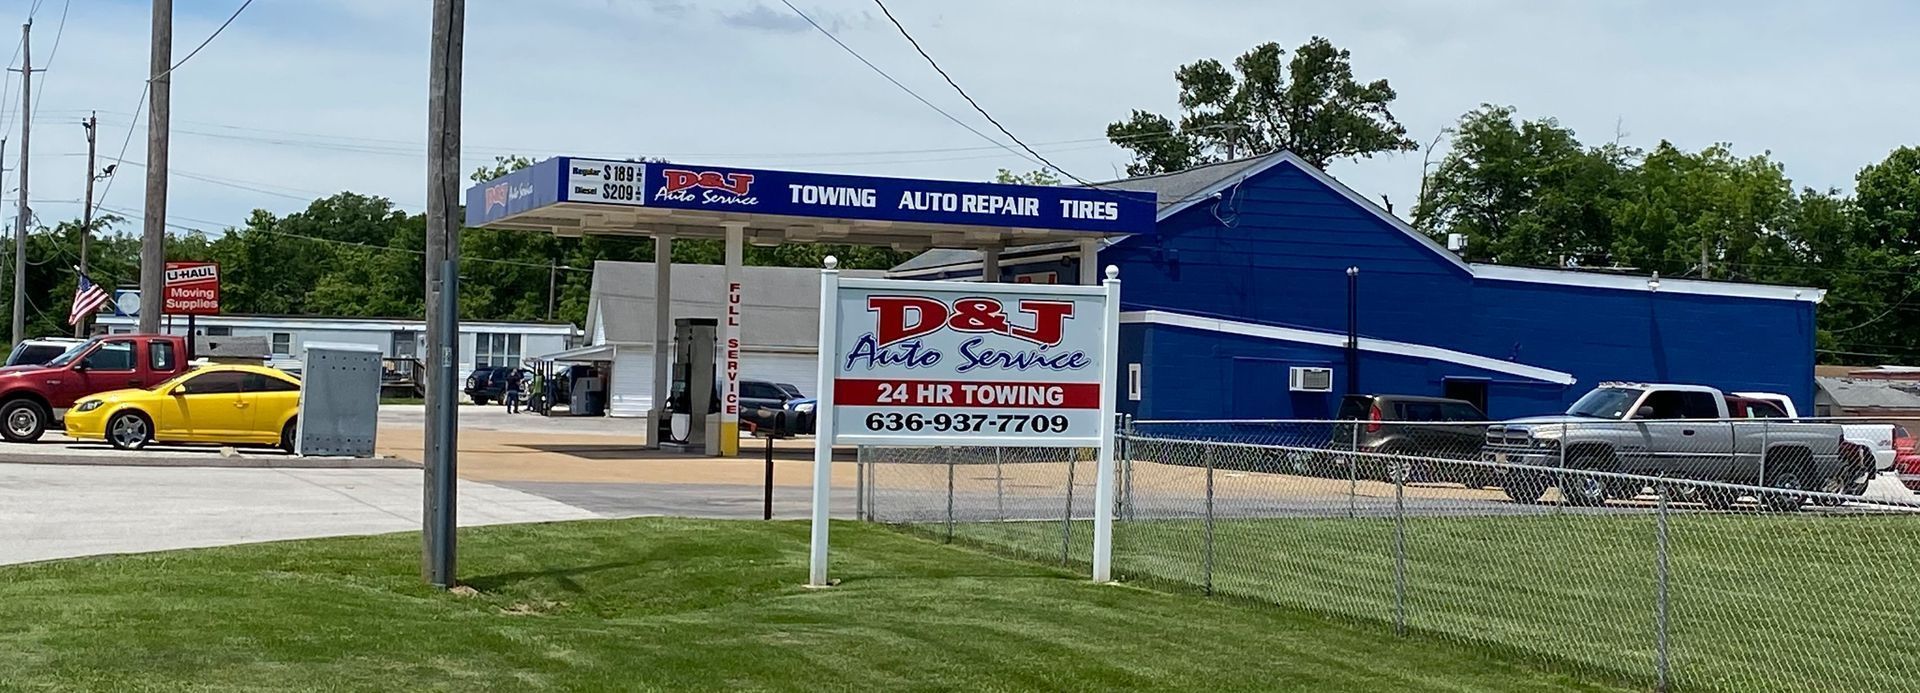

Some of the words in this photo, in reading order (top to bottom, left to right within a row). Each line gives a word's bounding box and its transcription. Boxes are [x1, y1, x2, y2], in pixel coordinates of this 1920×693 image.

[573, 166, 601, 177] Regular
[663, 169, 754, 196] D&J
[574, 185, 597, 195] Diesel
[654, 186, 696, 202] Auto
[702, 190, 759, 205] Service
[789, 184, 876, 208] TOWING
[898, 190, 957, 212] AUTO
[962, 194, 1039, 217] REPAIR
[1060, 199, 1118, 220] TIRES
[167, 267, 215, 280] U-HAUL
[166, 298, 218, 310] Supplies
[171, 287, 215, 300] Moving
[728, 283, 740, 326] FULL
[866, 294, 1075, 348] D&J
[845, 332, 943, 372] Auto
[955, 335, 1092, 373] Service
[726, 338, 739, 414] SERVICE
[876, 383, 908, 404] 24
[916, 384, 954, 405] HR
[961, 384, 1065, 406] TOWING
[865, 412, 1069, 433] 636-937-7709
